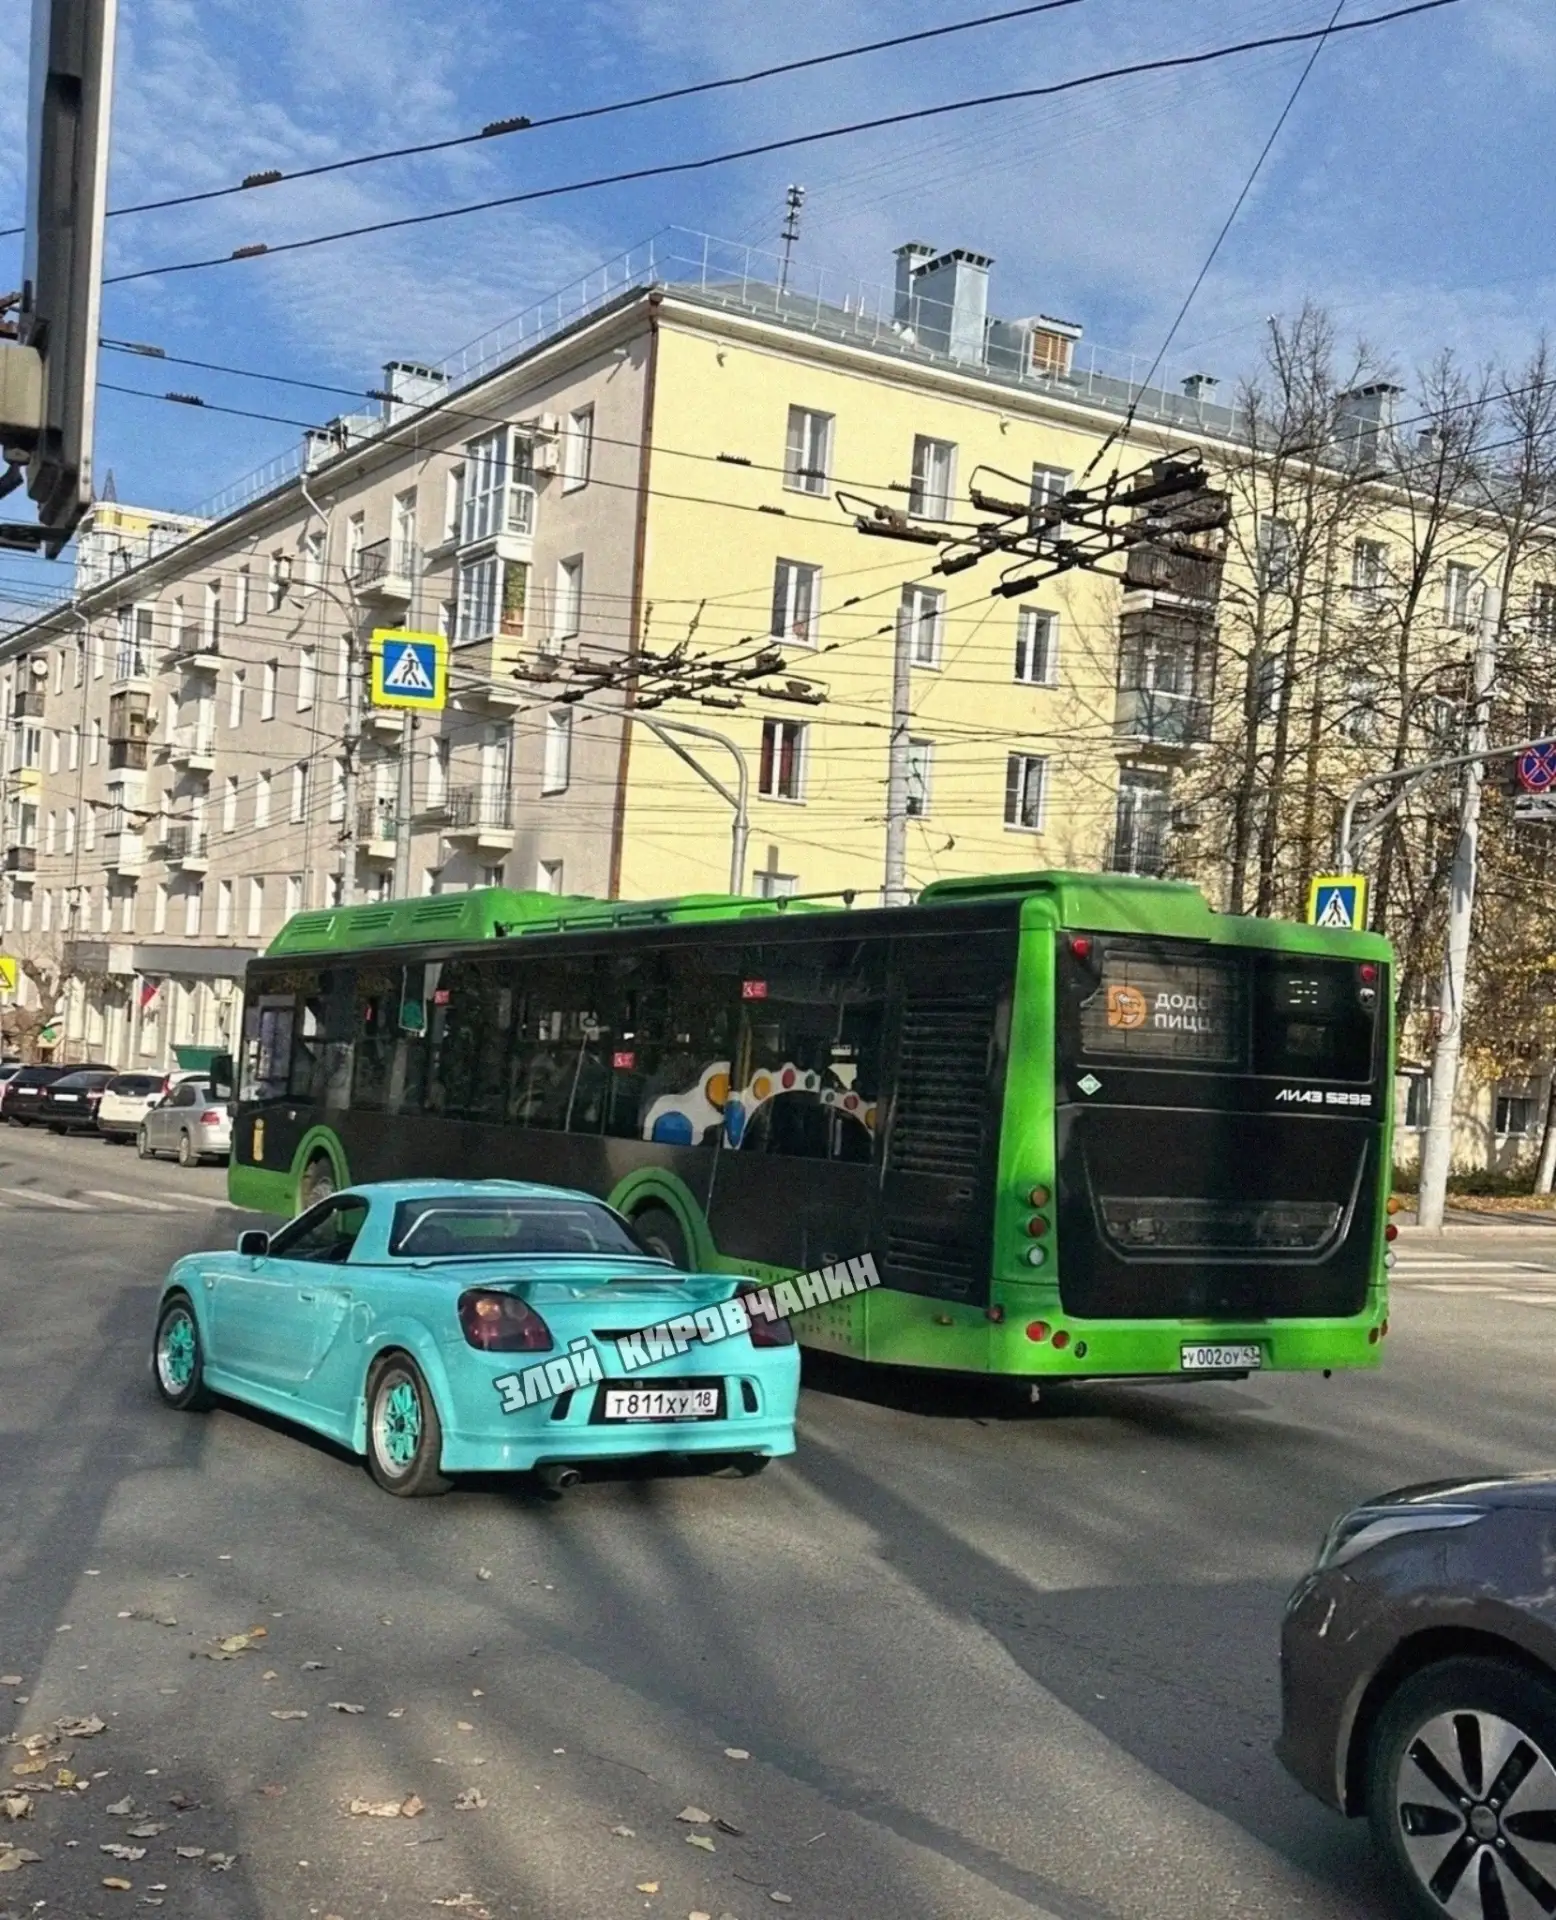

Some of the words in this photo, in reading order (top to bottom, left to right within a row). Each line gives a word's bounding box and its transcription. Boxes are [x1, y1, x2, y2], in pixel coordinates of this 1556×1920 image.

[1274, 1088, 1323, 1103] ЛИАЗ
[1325, 1091, 1372, 1107] 5292
[695, 1391, 712, 1407] 18
